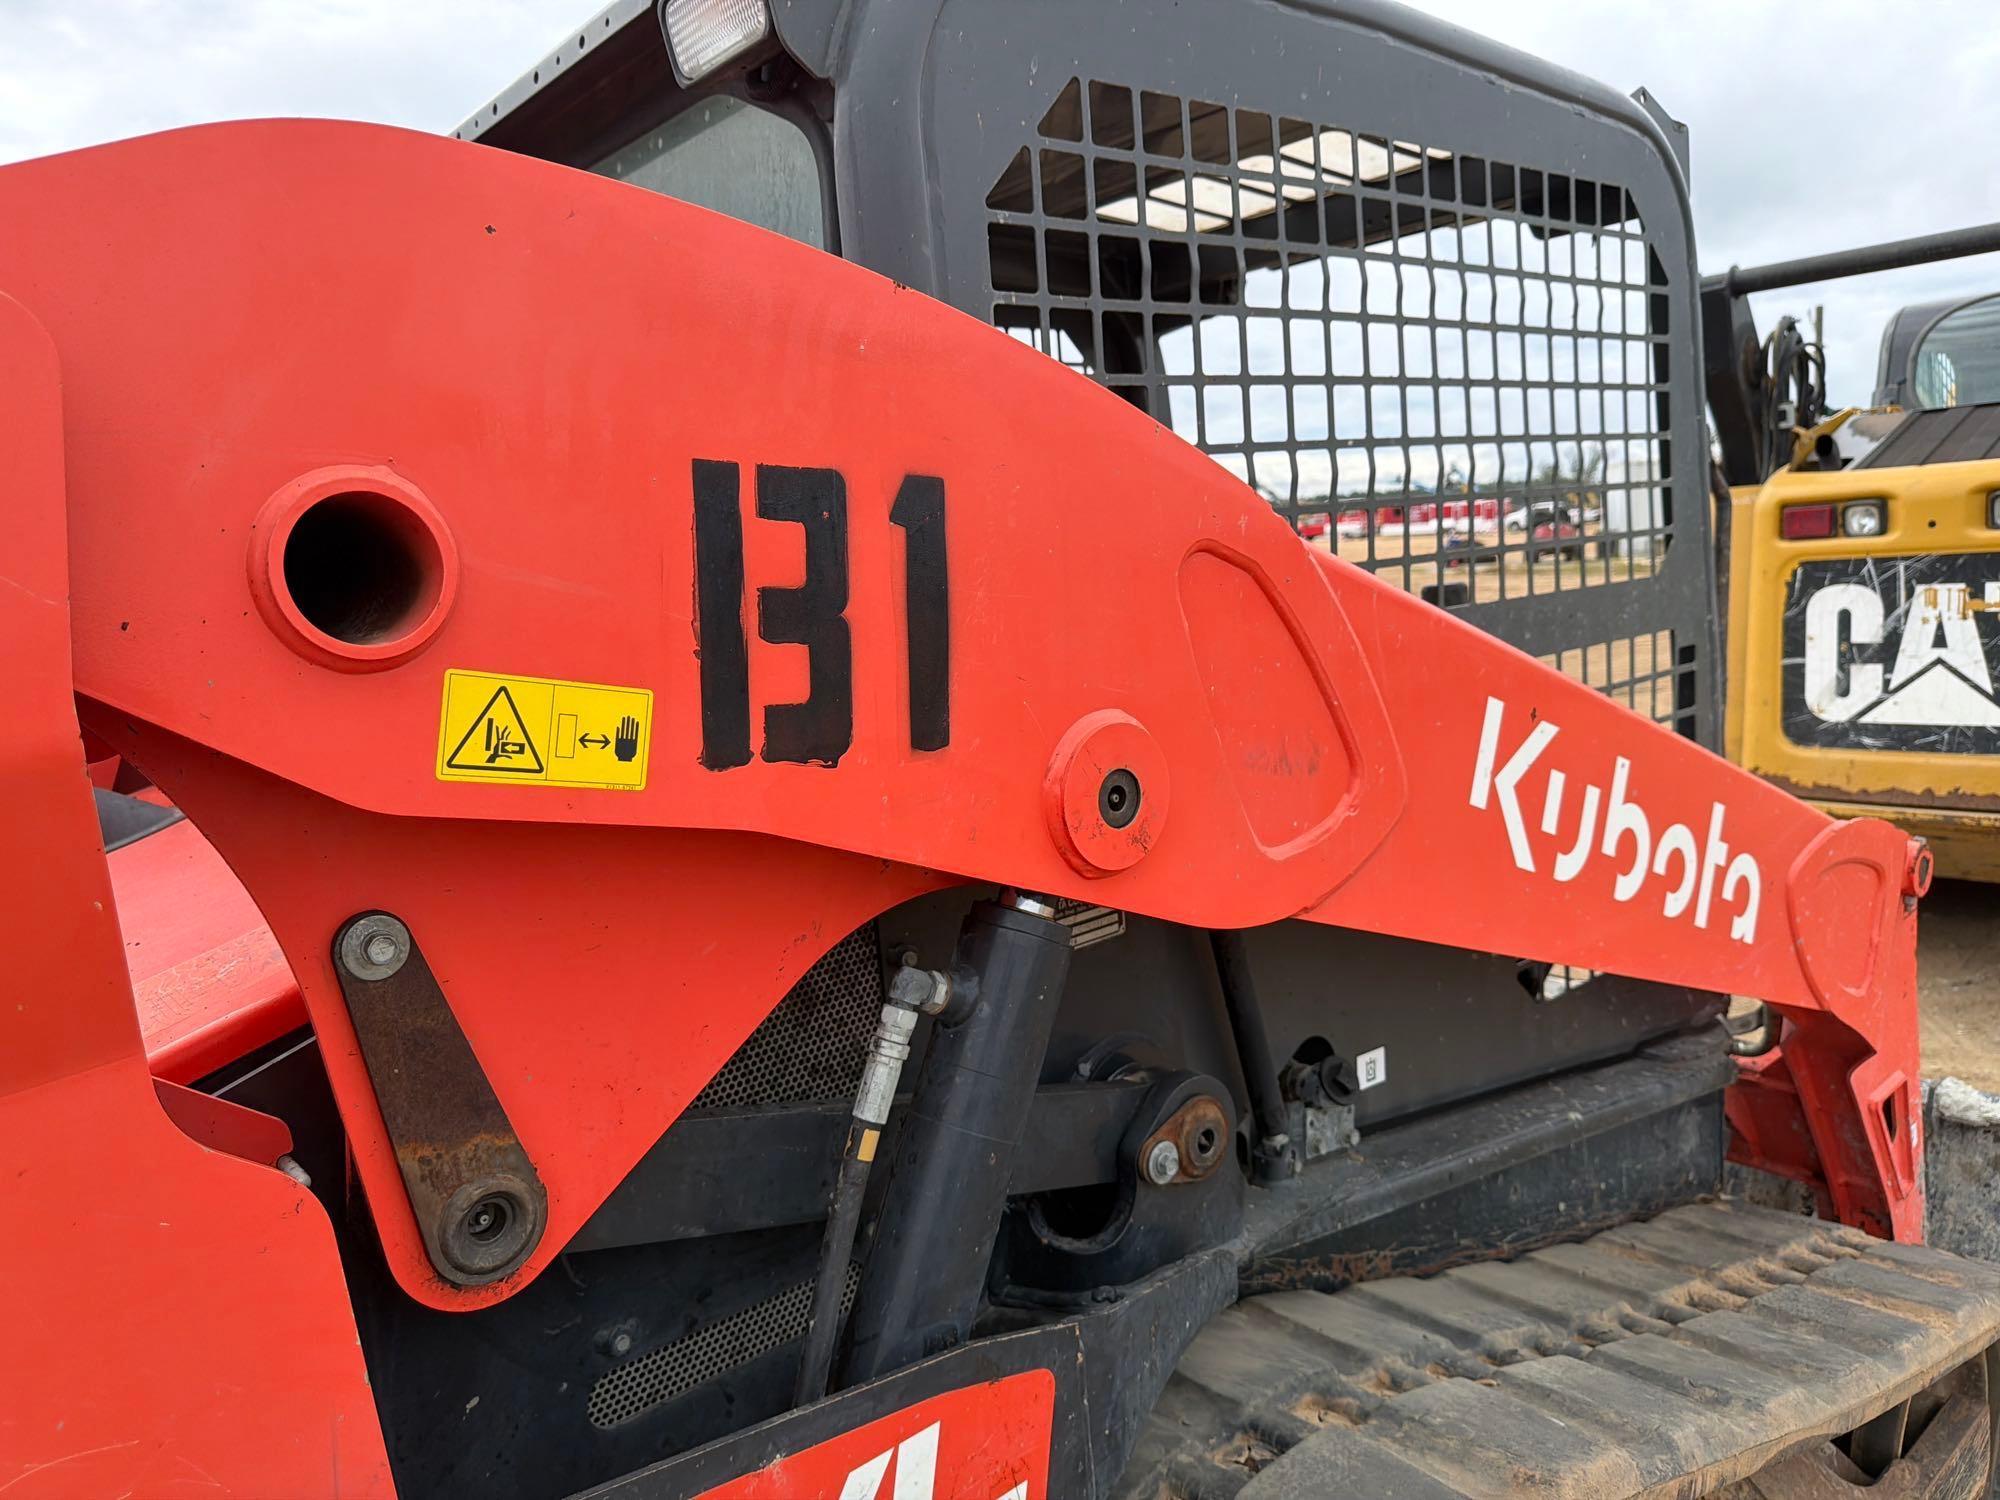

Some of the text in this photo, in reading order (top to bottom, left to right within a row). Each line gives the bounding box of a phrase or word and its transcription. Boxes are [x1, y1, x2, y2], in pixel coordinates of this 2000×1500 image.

[692, 458, 950, 770] B1
[1804, 582, 2000, 723] CA
[1469, 696, 1761, 945] Kubota
